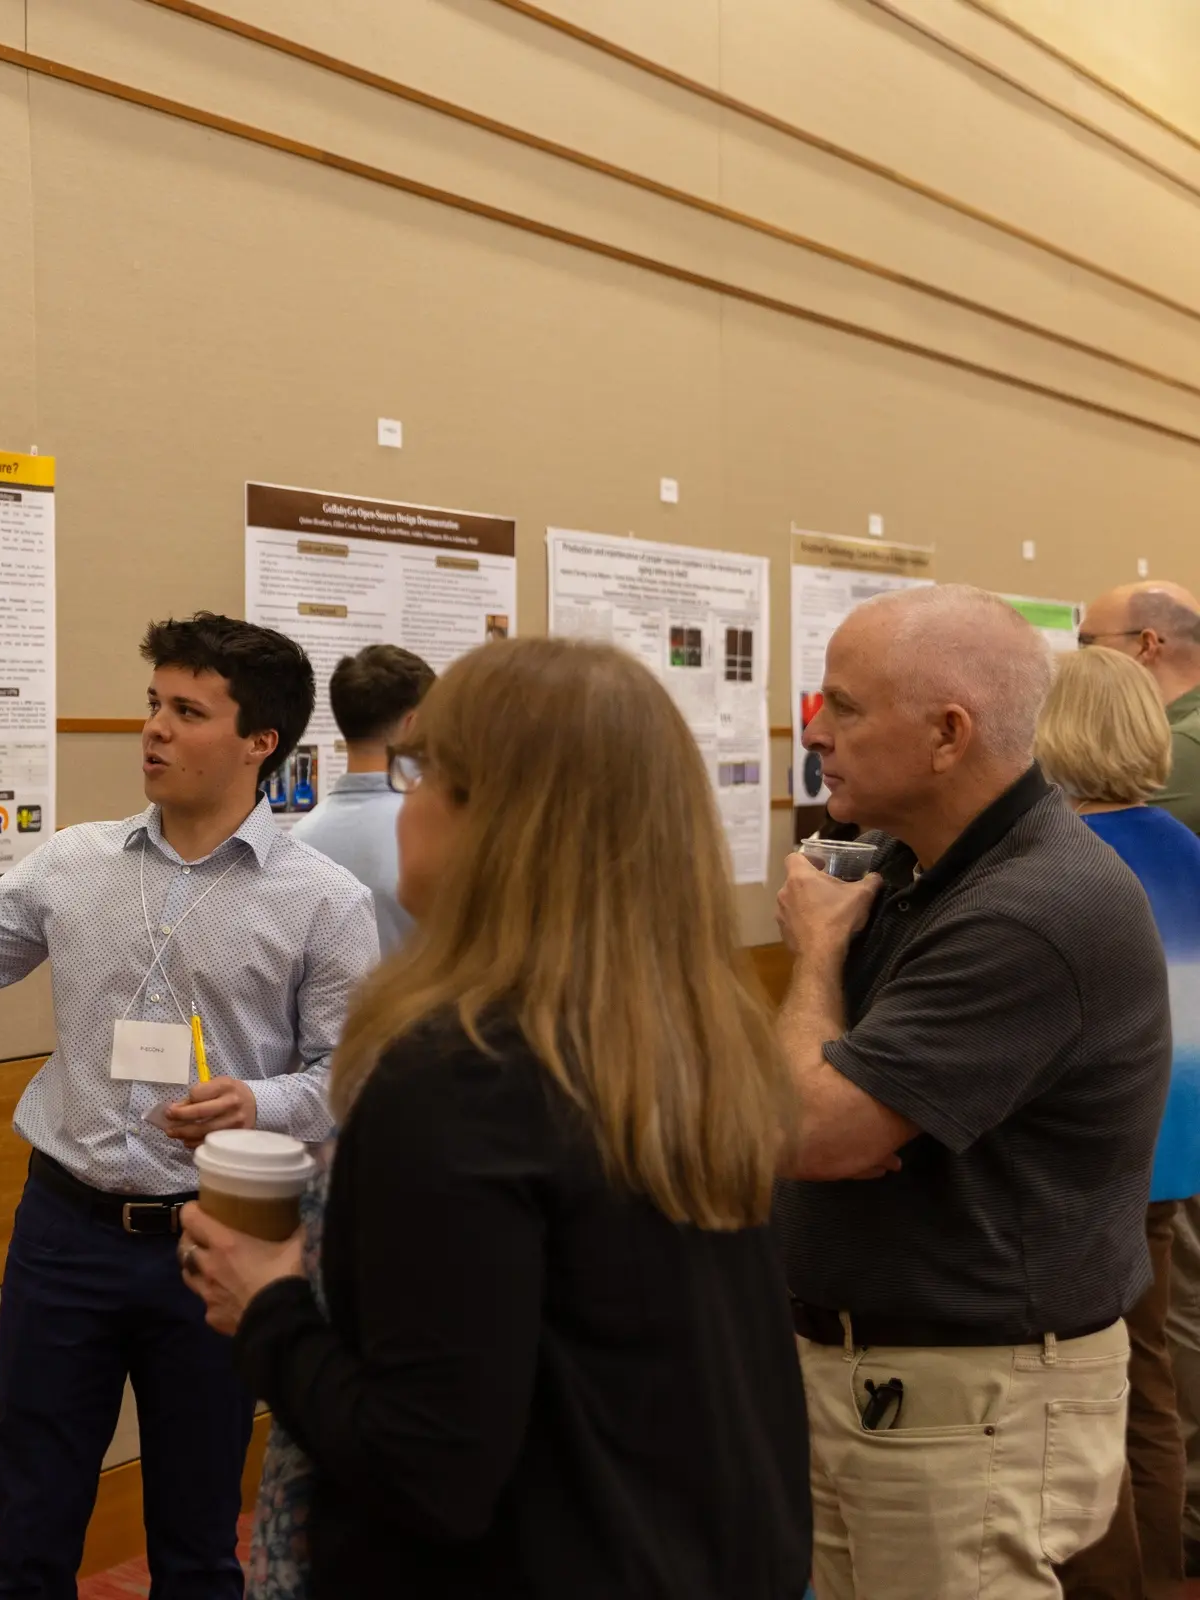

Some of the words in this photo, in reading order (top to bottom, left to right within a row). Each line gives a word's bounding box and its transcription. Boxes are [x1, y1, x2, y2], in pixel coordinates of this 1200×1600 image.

[358, 506, 396, 521] Open-Source
[397, 512, 416, 526] Design
[418, 516, 460, 530] Documentation
